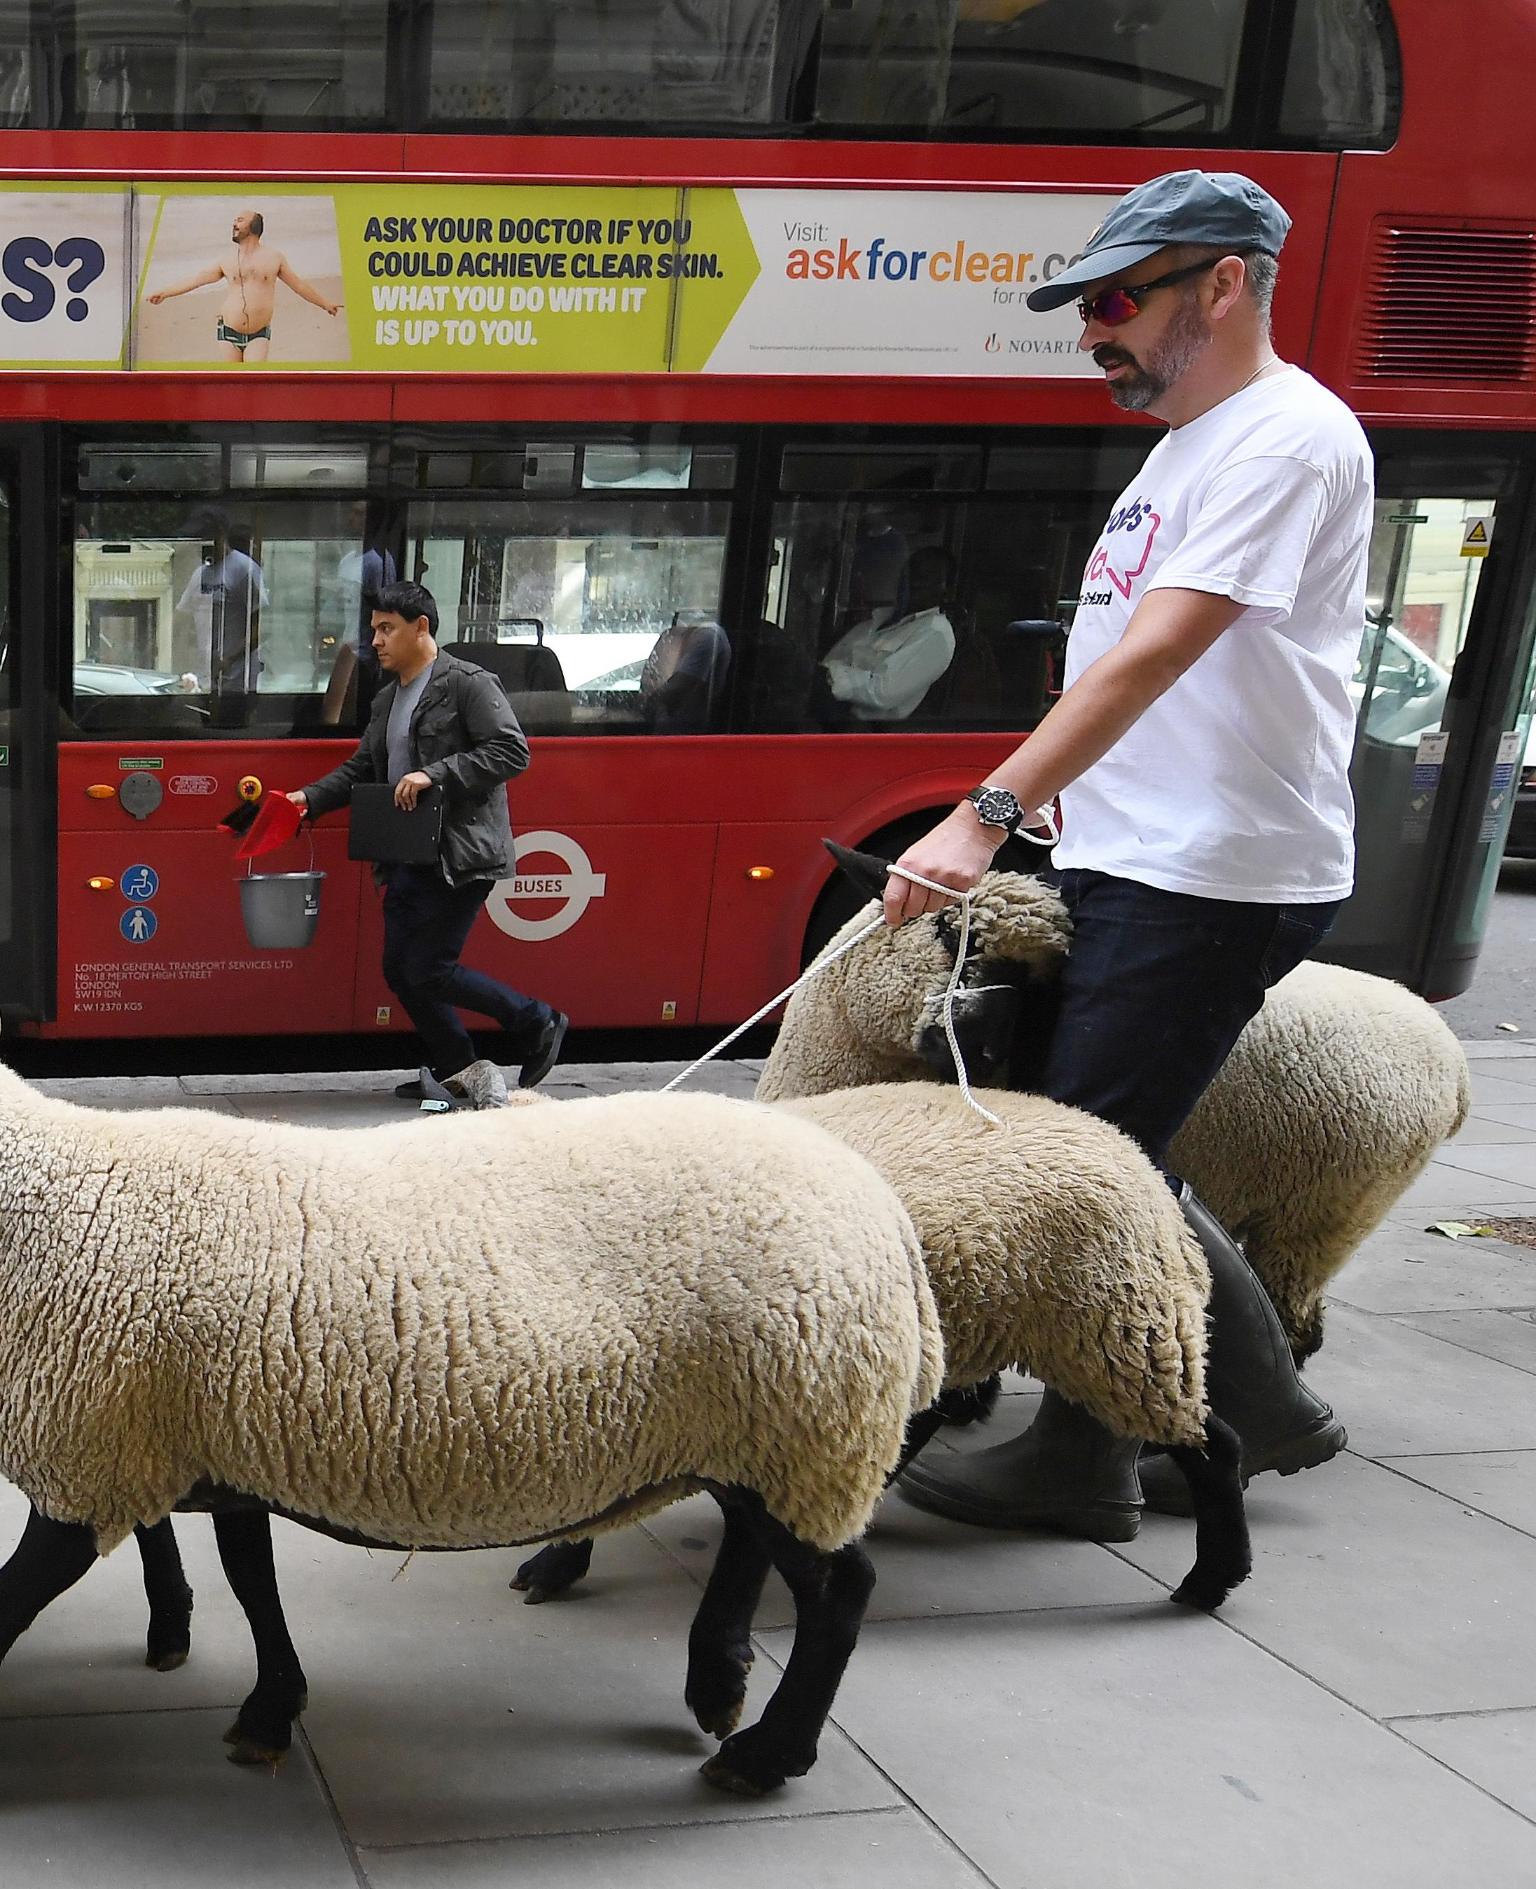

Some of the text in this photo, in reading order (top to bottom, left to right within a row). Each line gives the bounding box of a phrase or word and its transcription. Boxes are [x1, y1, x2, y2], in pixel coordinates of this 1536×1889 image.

[364, 217, 692, 245] ASK YOUR DOCTOR IF YOU
[783, 222, 829, 242] Visit:
[368, 251, 724, 279] COULD ACHIEVE CLEAR SKIN.
[372, 286, 647, 313] WHAT YOU DO WITH IT
[993, 287, 1015, 304] for
[375, 319, 538, 345] IS UP TO YOU.
[1008, 339, 1080, 354] NOVARTI
[514, 879, 562, 893] BUSES
[75, 960, 294, 972] LONDON GENERAL TRANSPORT SERVICES LTD
[107, 971, 150, 980] MERTON
[152, 971, 176, 980] HIGH
[178, 970, 212, 979] STREET
[75, 981, 120, 990] LONDON
[75, 990, 102, 999] SW19
[124, 1002, 143, 1011] KGS
